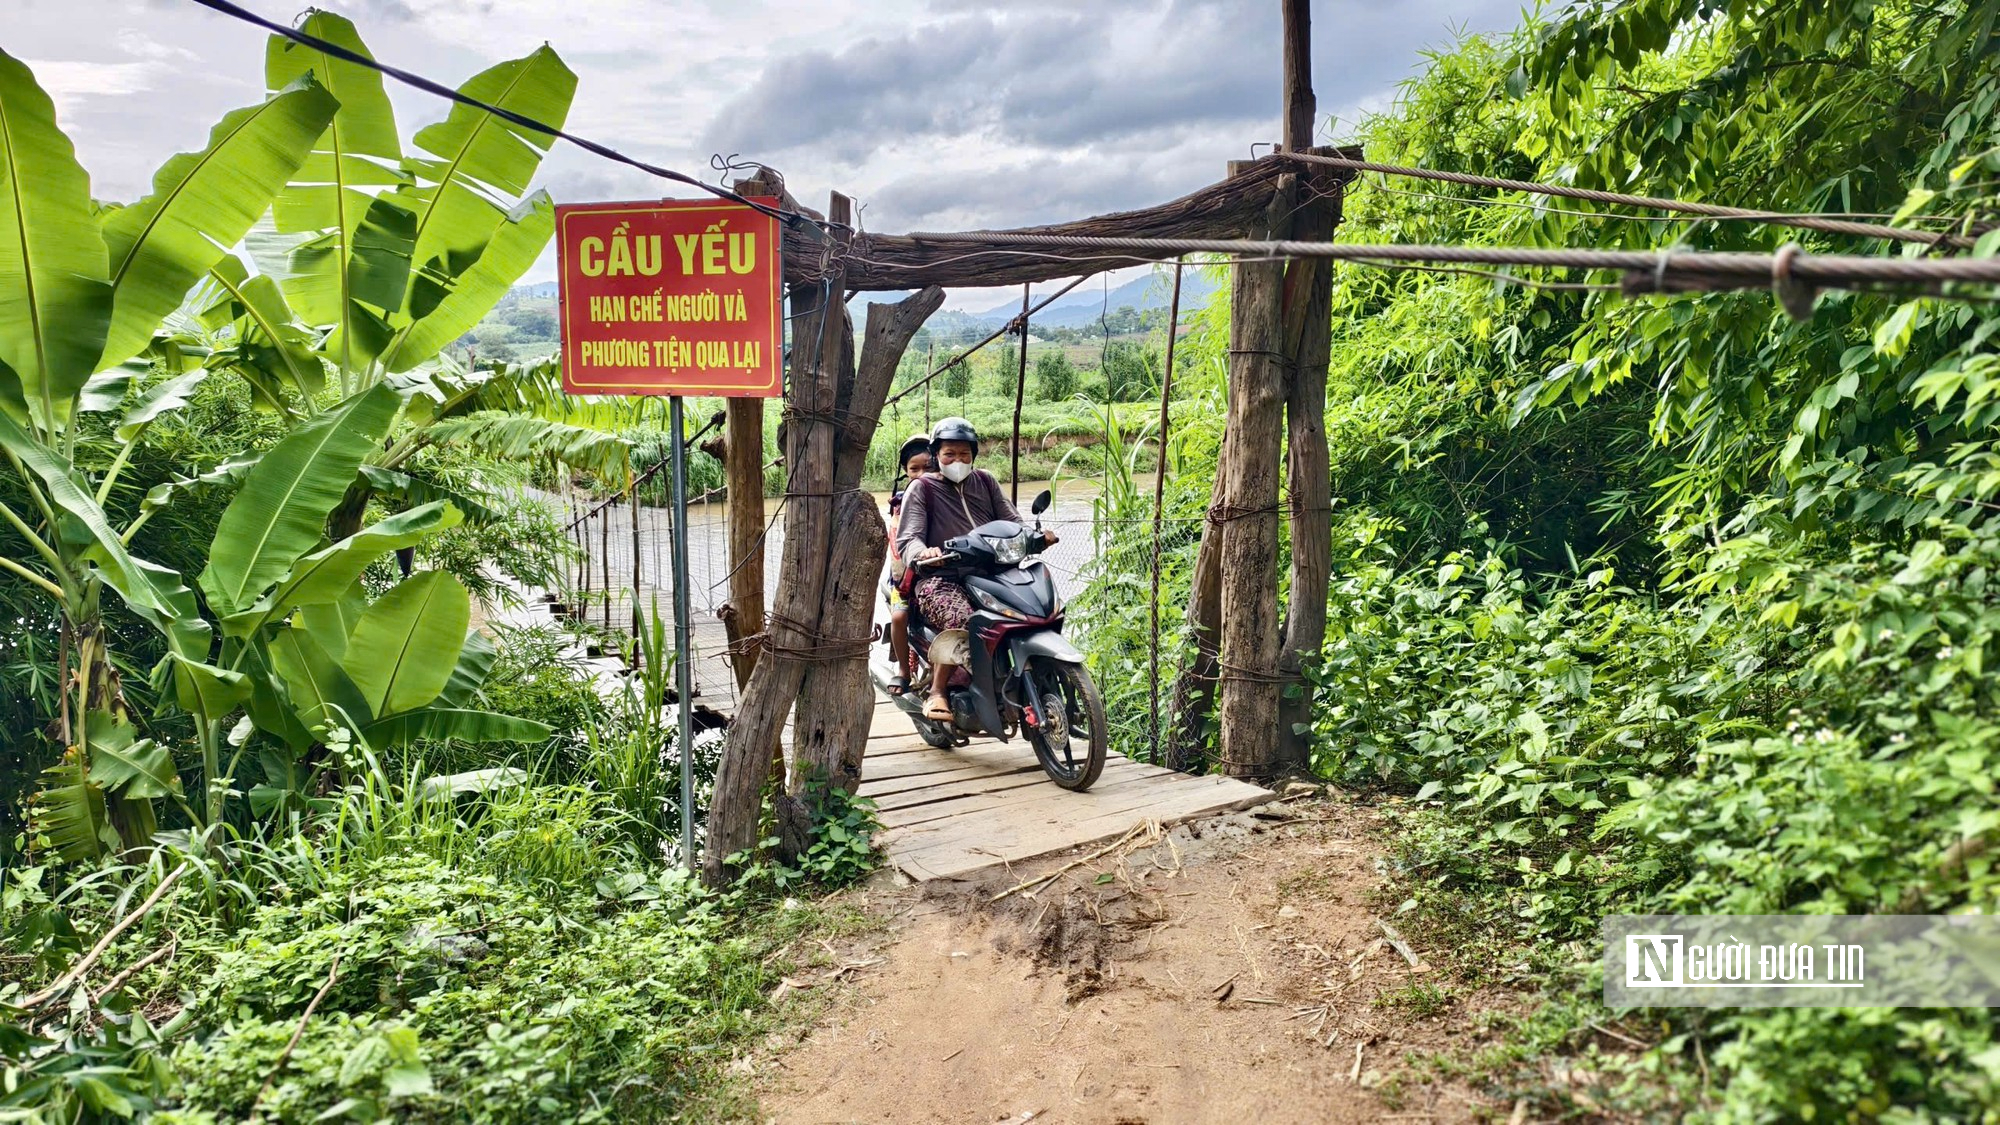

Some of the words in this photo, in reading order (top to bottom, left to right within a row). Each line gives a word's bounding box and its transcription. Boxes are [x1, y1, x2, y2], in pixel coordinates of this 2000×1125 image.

[579, 221, 663, 277] CẦU
[673, 219, 756, 275] YẾU
[590, 295, 626, 328] HẠN
[629, 287, 663, 322] CHẾ
[667, 288, 720, 322] NGƯỜI
[723, 289, 747, 321] VÀ
[581, 338, 650, 367] PHƯƠNG
[653, 336, 692, 373] TIỆN
[696, 341, 730, 370] QUA
[733, 341, 761, 374] LẠI
